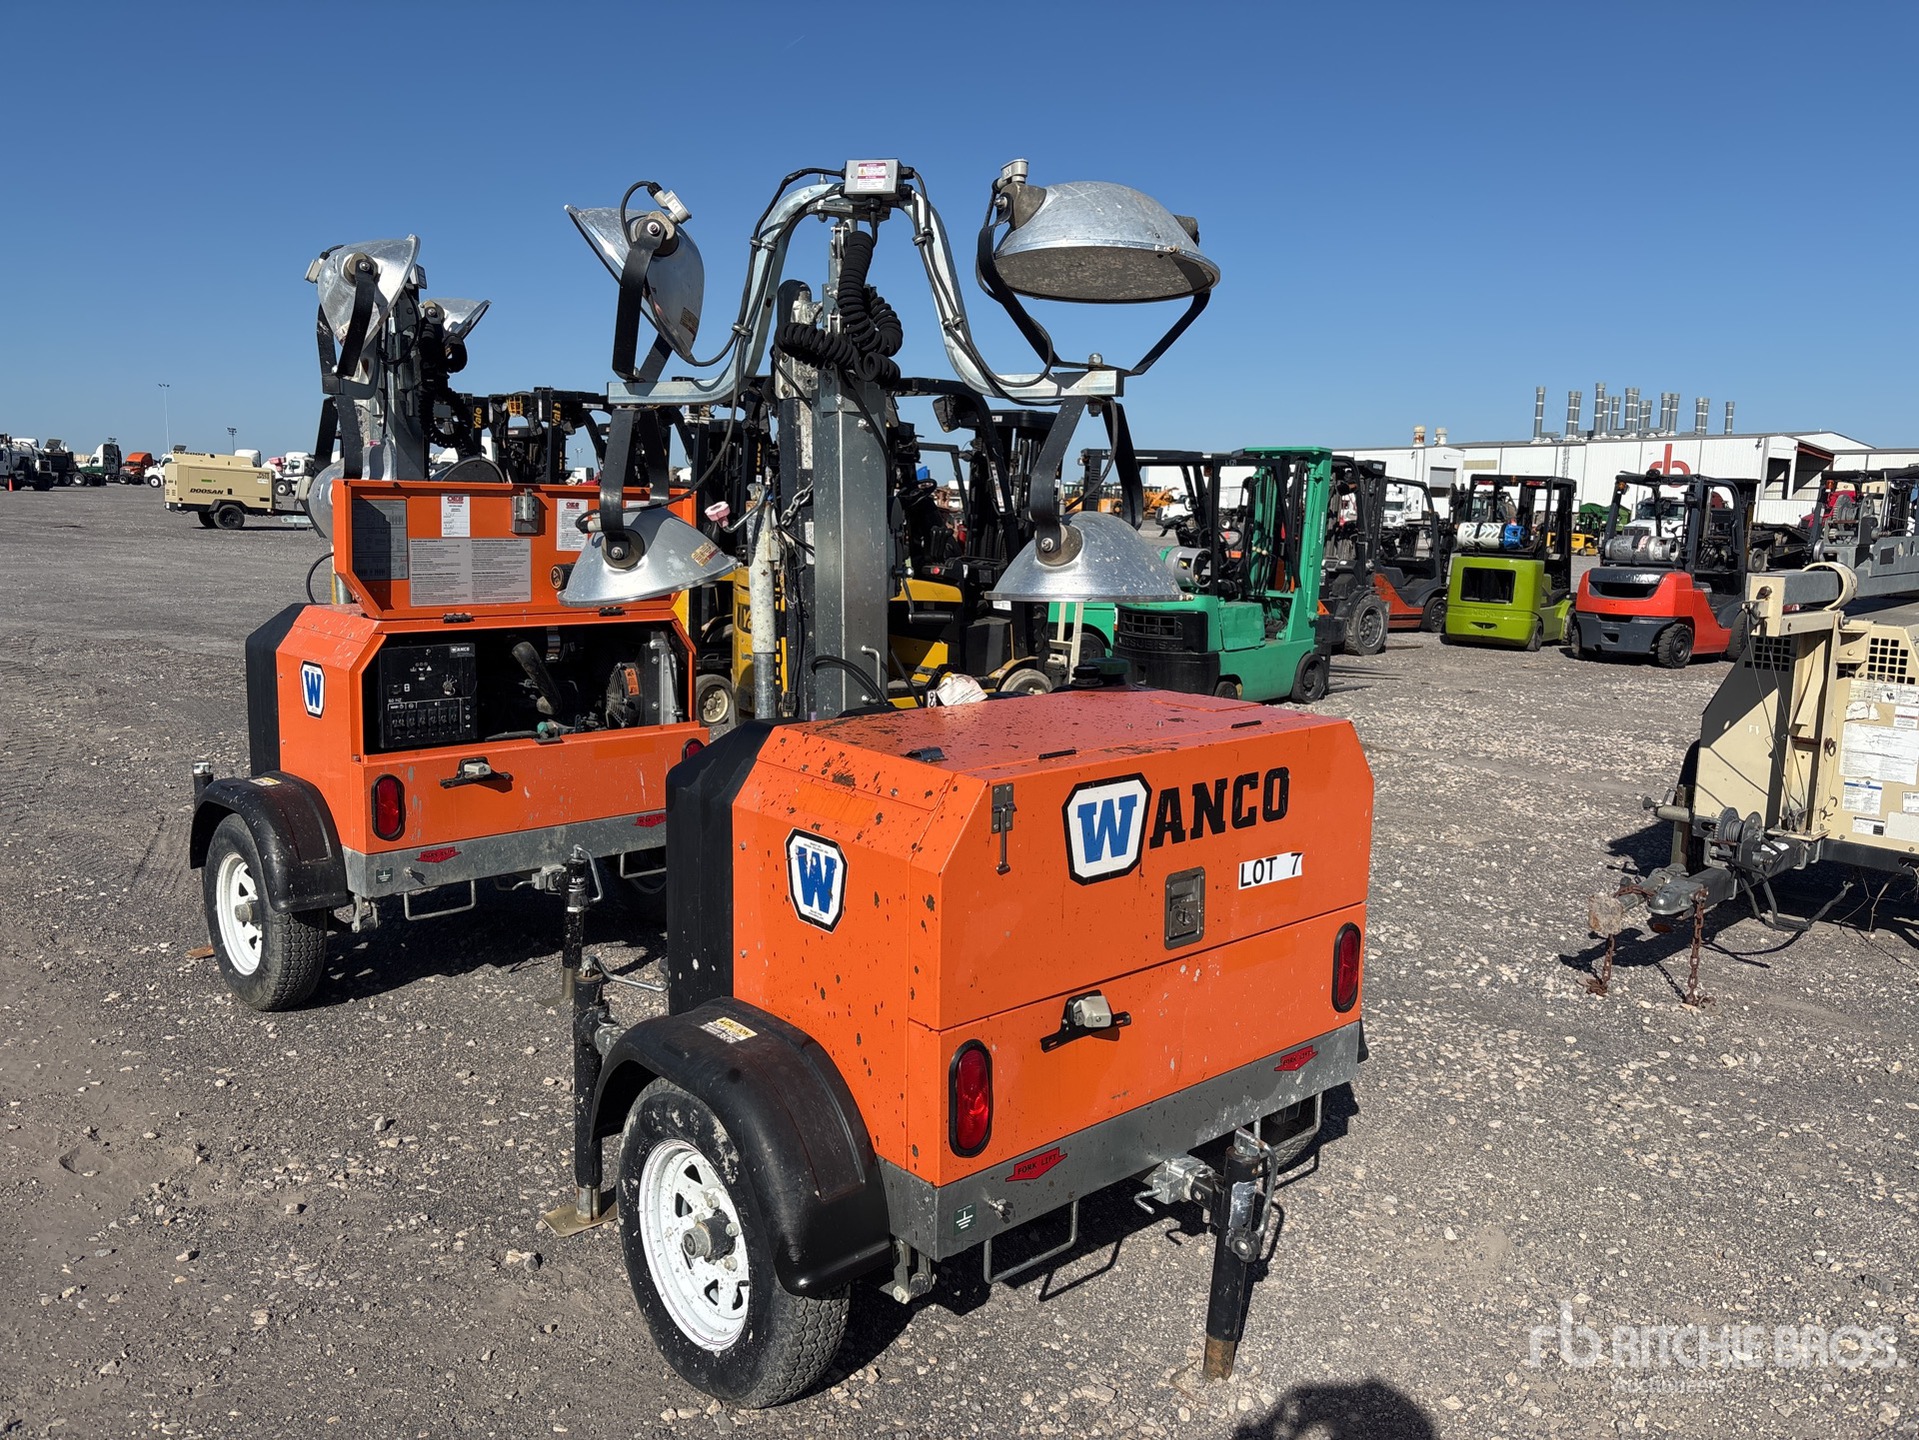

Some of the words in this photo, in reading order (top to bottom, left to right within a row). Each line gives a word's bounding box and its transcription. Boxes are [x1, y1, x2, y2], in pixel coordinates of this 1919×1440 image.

[474, 407, 482, 429] Yale
[189, 487, 224, 495] DOOSAN
[304, 670, 322, 709] W
[1077, 766, 1290, 864] WANCO
[796, 845, 837, 915] W
[1240, 857, 1278, 888] LOT
[1290, 852, 1304, 876] 7
[1017, 1162, 1037, 1175] FORK
[1040, 1154, 1058, 1166] LIFT
